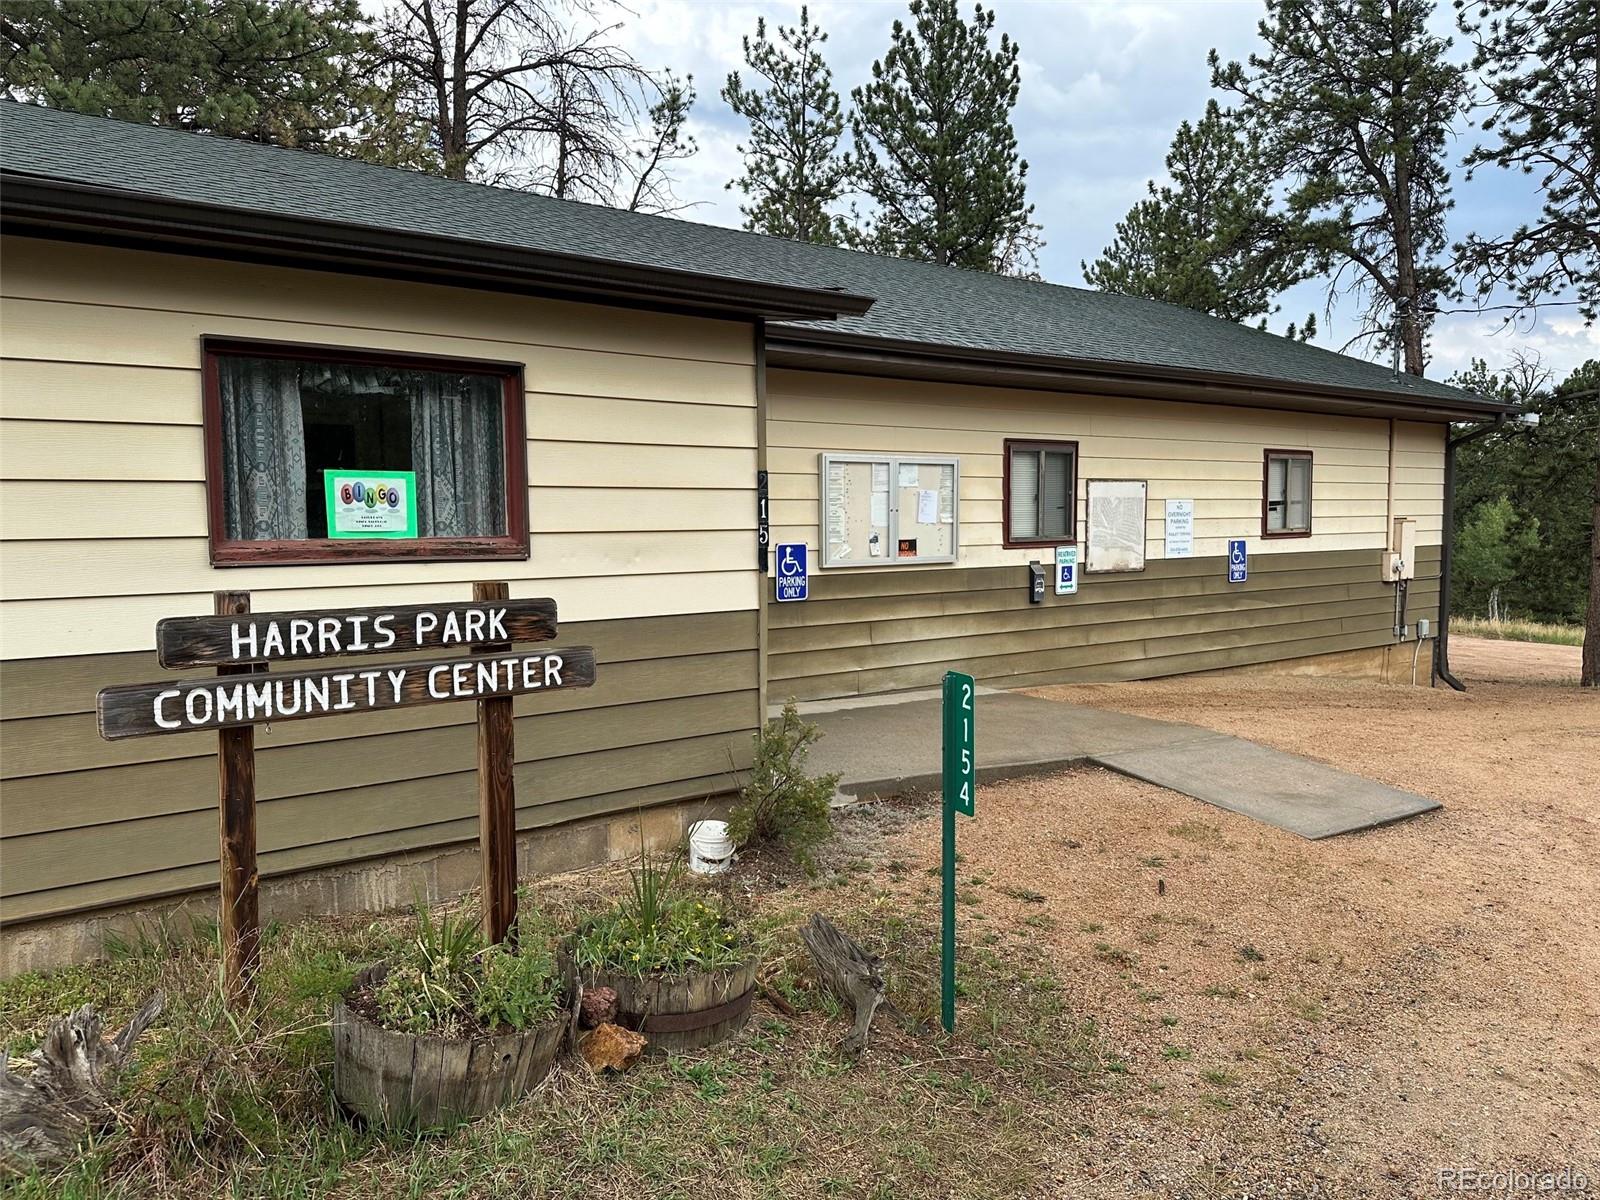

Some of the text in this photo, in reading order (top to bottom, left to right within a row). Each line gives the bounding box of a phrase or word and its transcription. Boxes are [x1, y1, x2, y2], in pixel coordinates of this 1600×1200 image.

[344, 485, 397, 504] BINGO
[900, 541, 909, 550] NO
[779, 576, 805, 587] PARKING
[784, 586, 800, 598] ONLY
[230, 607, 509, 659] HARRIS PARK
[153, 654, 563, 729] COMMUNITY CENTER
[959, 683, 971, 807] 2154
